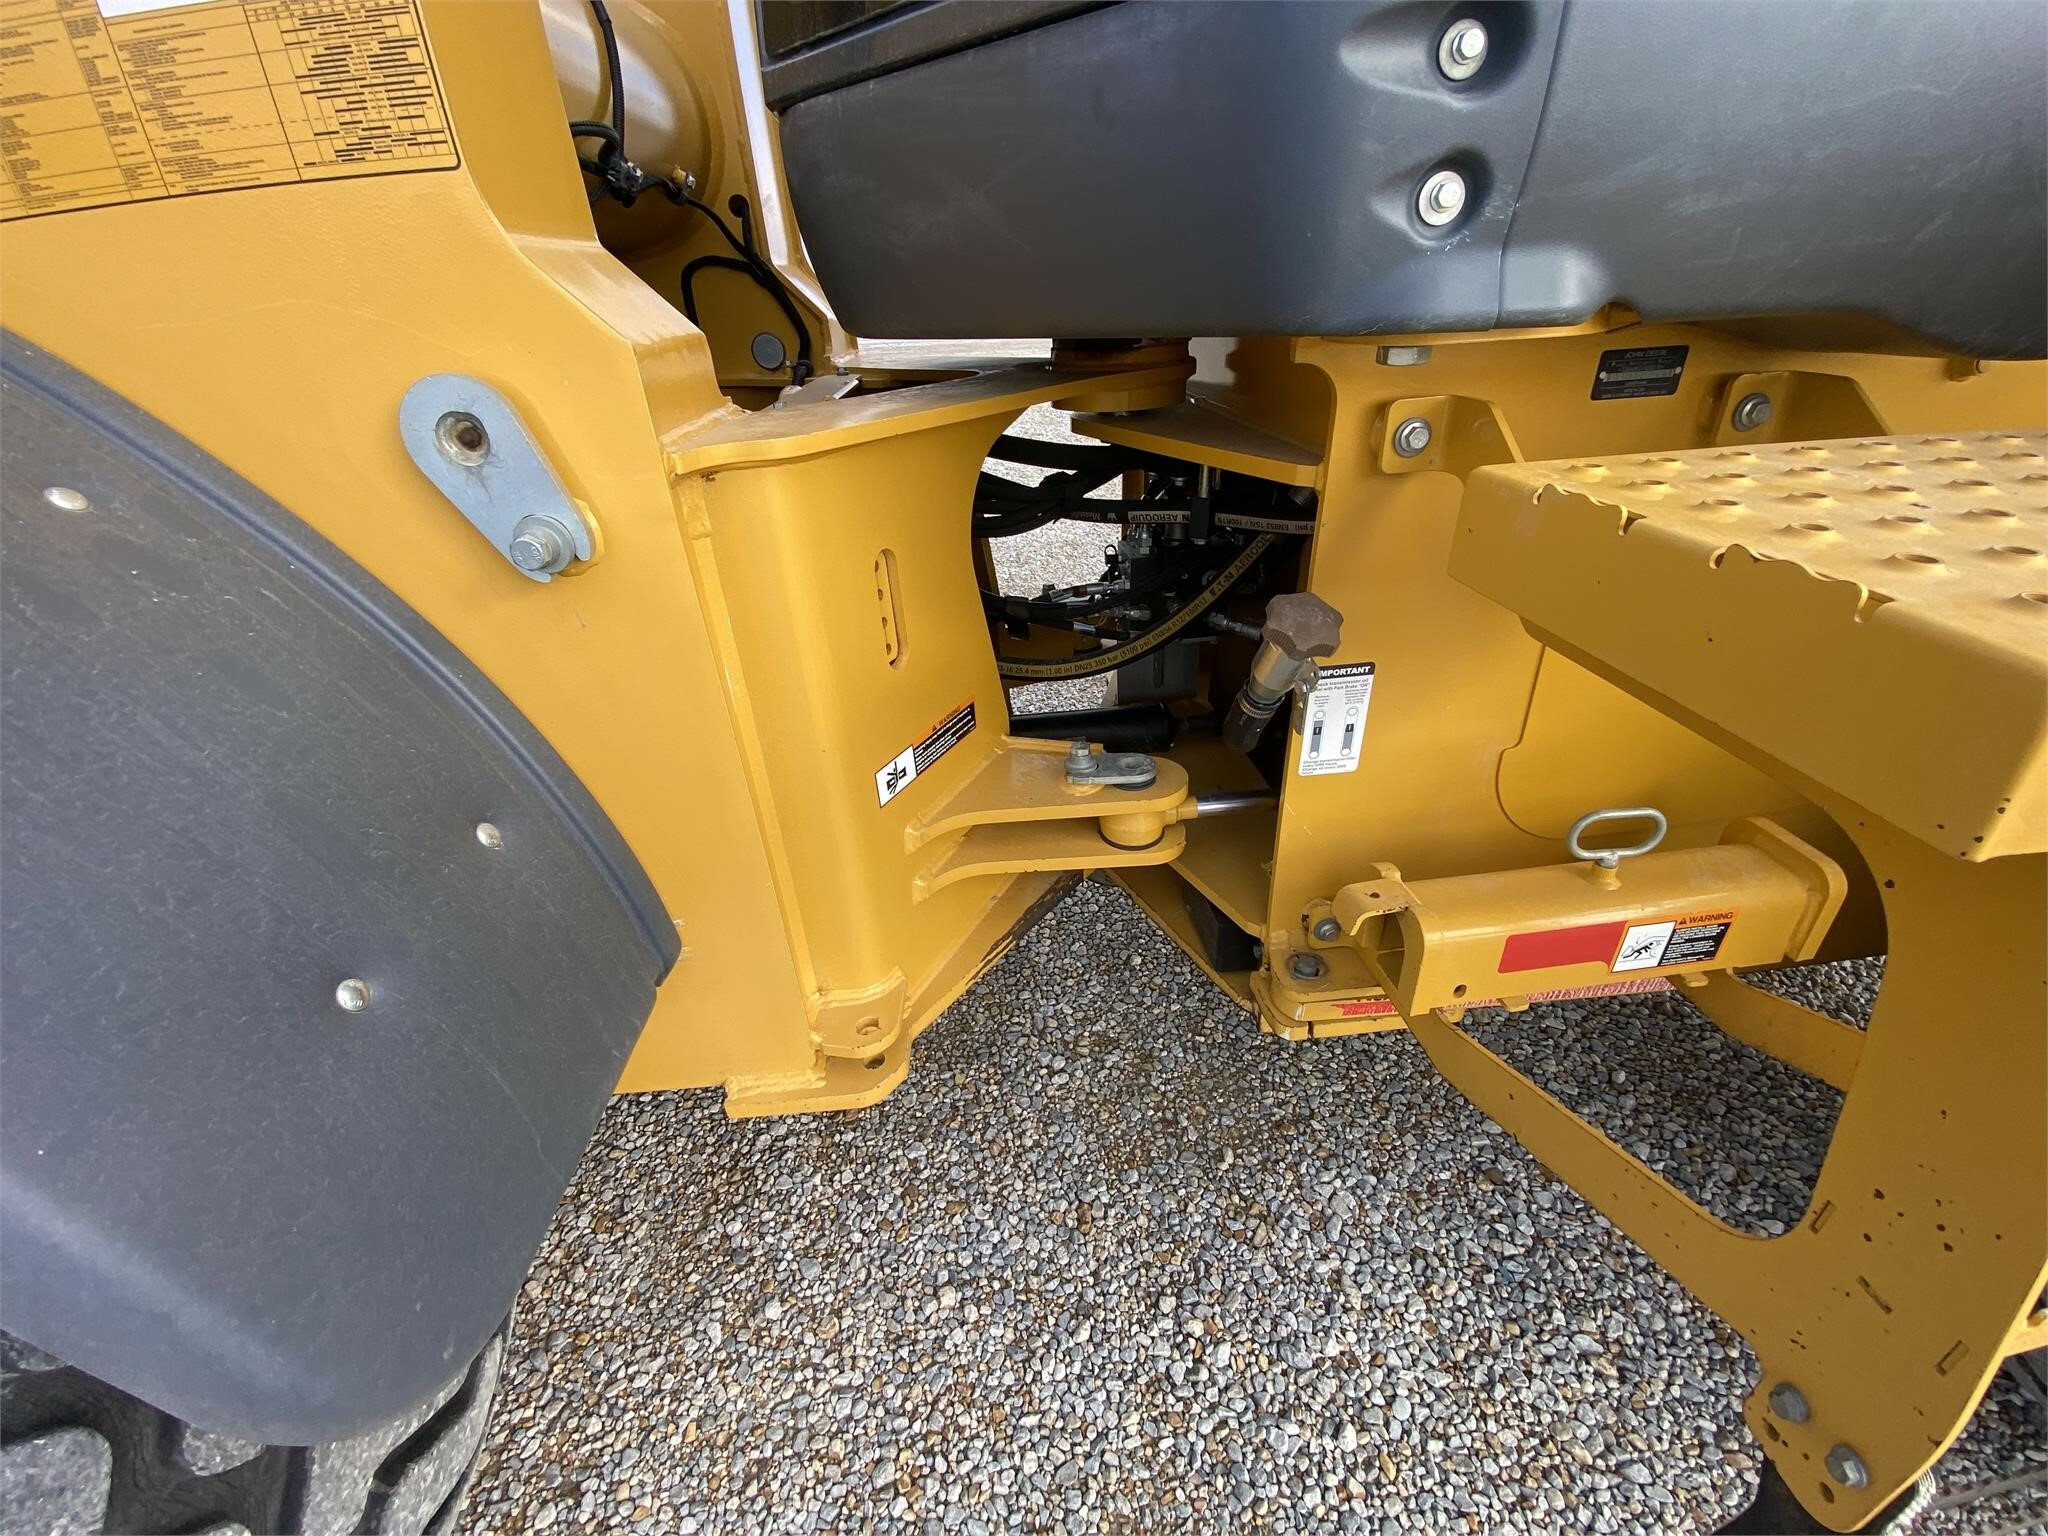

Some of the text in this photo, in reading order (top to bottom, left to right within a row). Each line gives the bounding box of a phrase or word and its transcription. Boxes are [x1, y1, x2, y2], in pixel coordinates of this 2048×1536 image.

[1130, 512, 1178, 522] AEROQUIP
[1074, 661, 1093, 672] DN25
[1094, 658, 1107, 668] 350
[1107, 653, 1119, 665] bar
[1318, 666, 1371, 677] MPORTANT
[1689, 911, 1734, 924] WARNING
